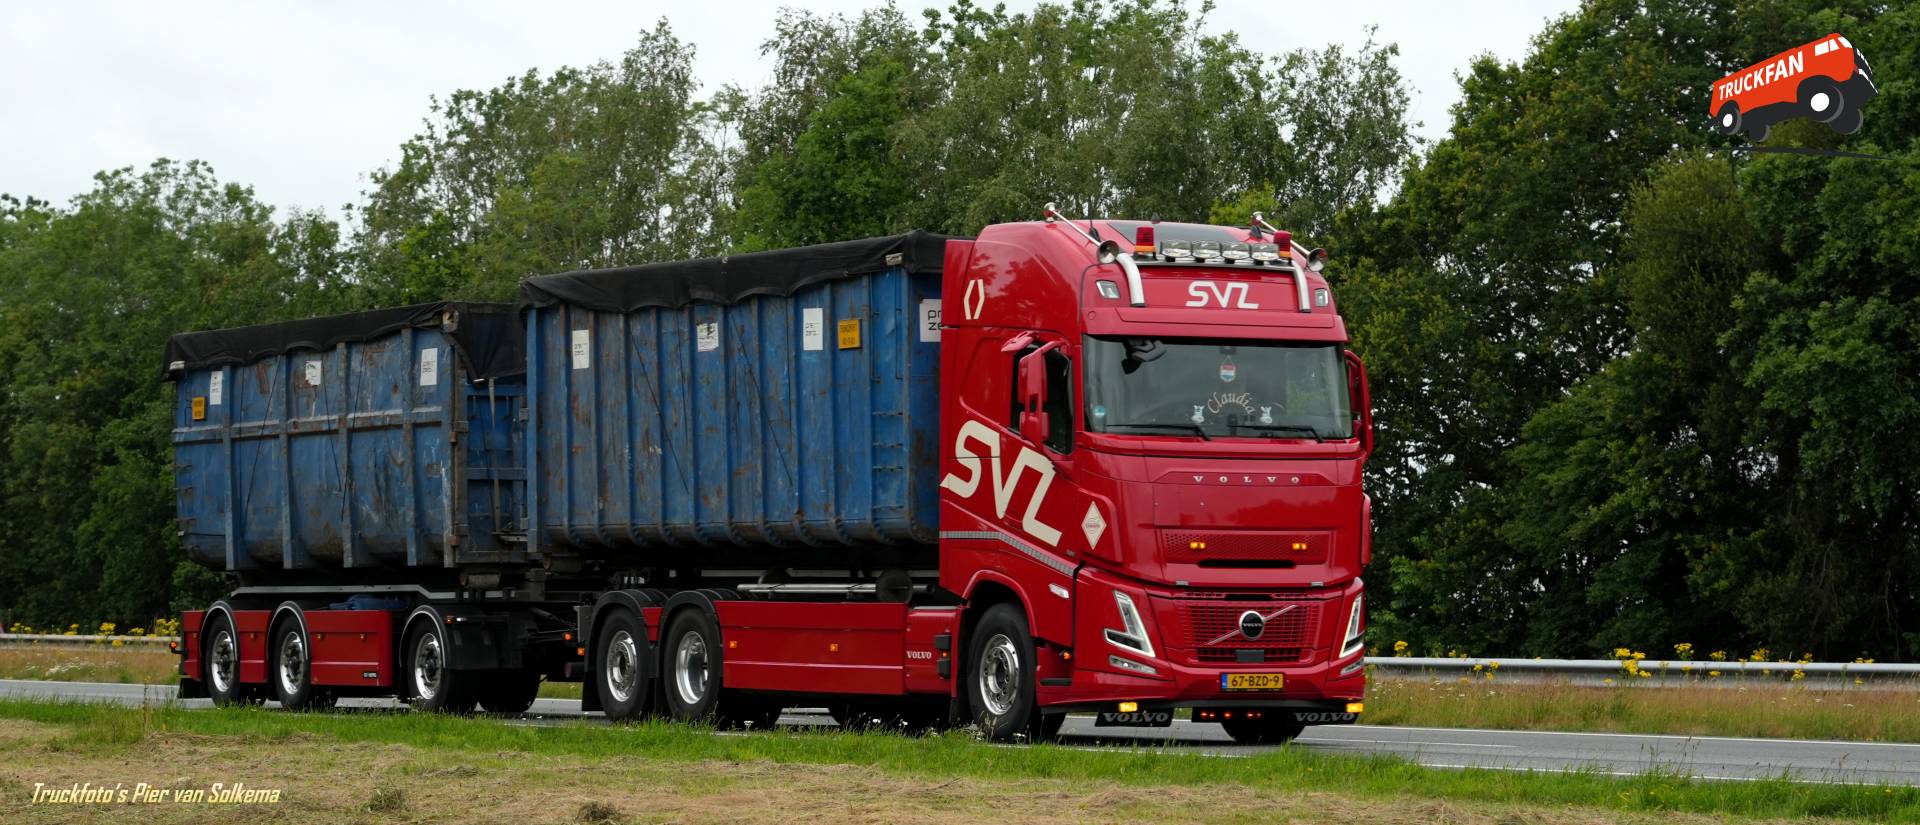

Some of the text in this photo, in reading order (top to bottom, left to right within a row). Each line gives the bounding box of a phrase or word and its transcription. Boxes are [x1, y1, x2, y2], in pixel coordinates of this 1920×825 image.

[1207, 391, 1256, 414] Claudia
[1193, 475, 1300, 484] VOLVO
[906, 650, 932, 660] VOLVO
[1231, 675, 1280, 687] 67-BZD-9
[1103, 712, 1169, 723] VOLVO
[1294, 712, 1354, 723] VOLVO
